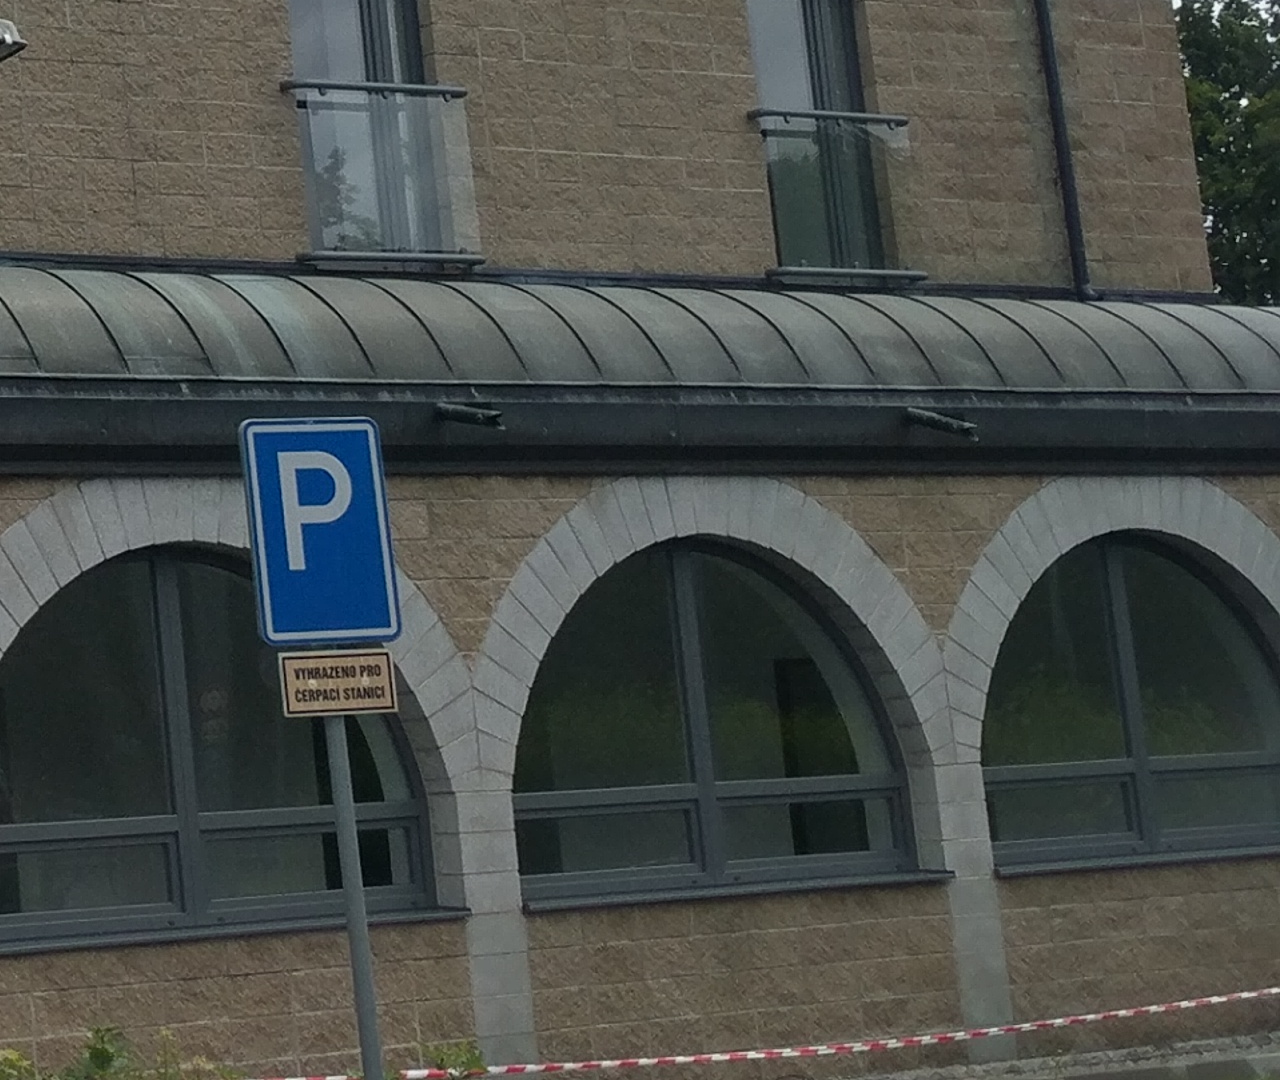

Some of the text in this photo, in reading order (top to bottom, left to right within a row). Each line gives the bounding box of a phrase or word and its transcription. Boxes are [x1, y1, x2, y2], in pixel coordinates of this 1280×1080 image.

[276, 450, 353, 571] P
[293, 664, 382, 681] VYHRAZENO PRO
[343, 685, 385, 701] STANICI
